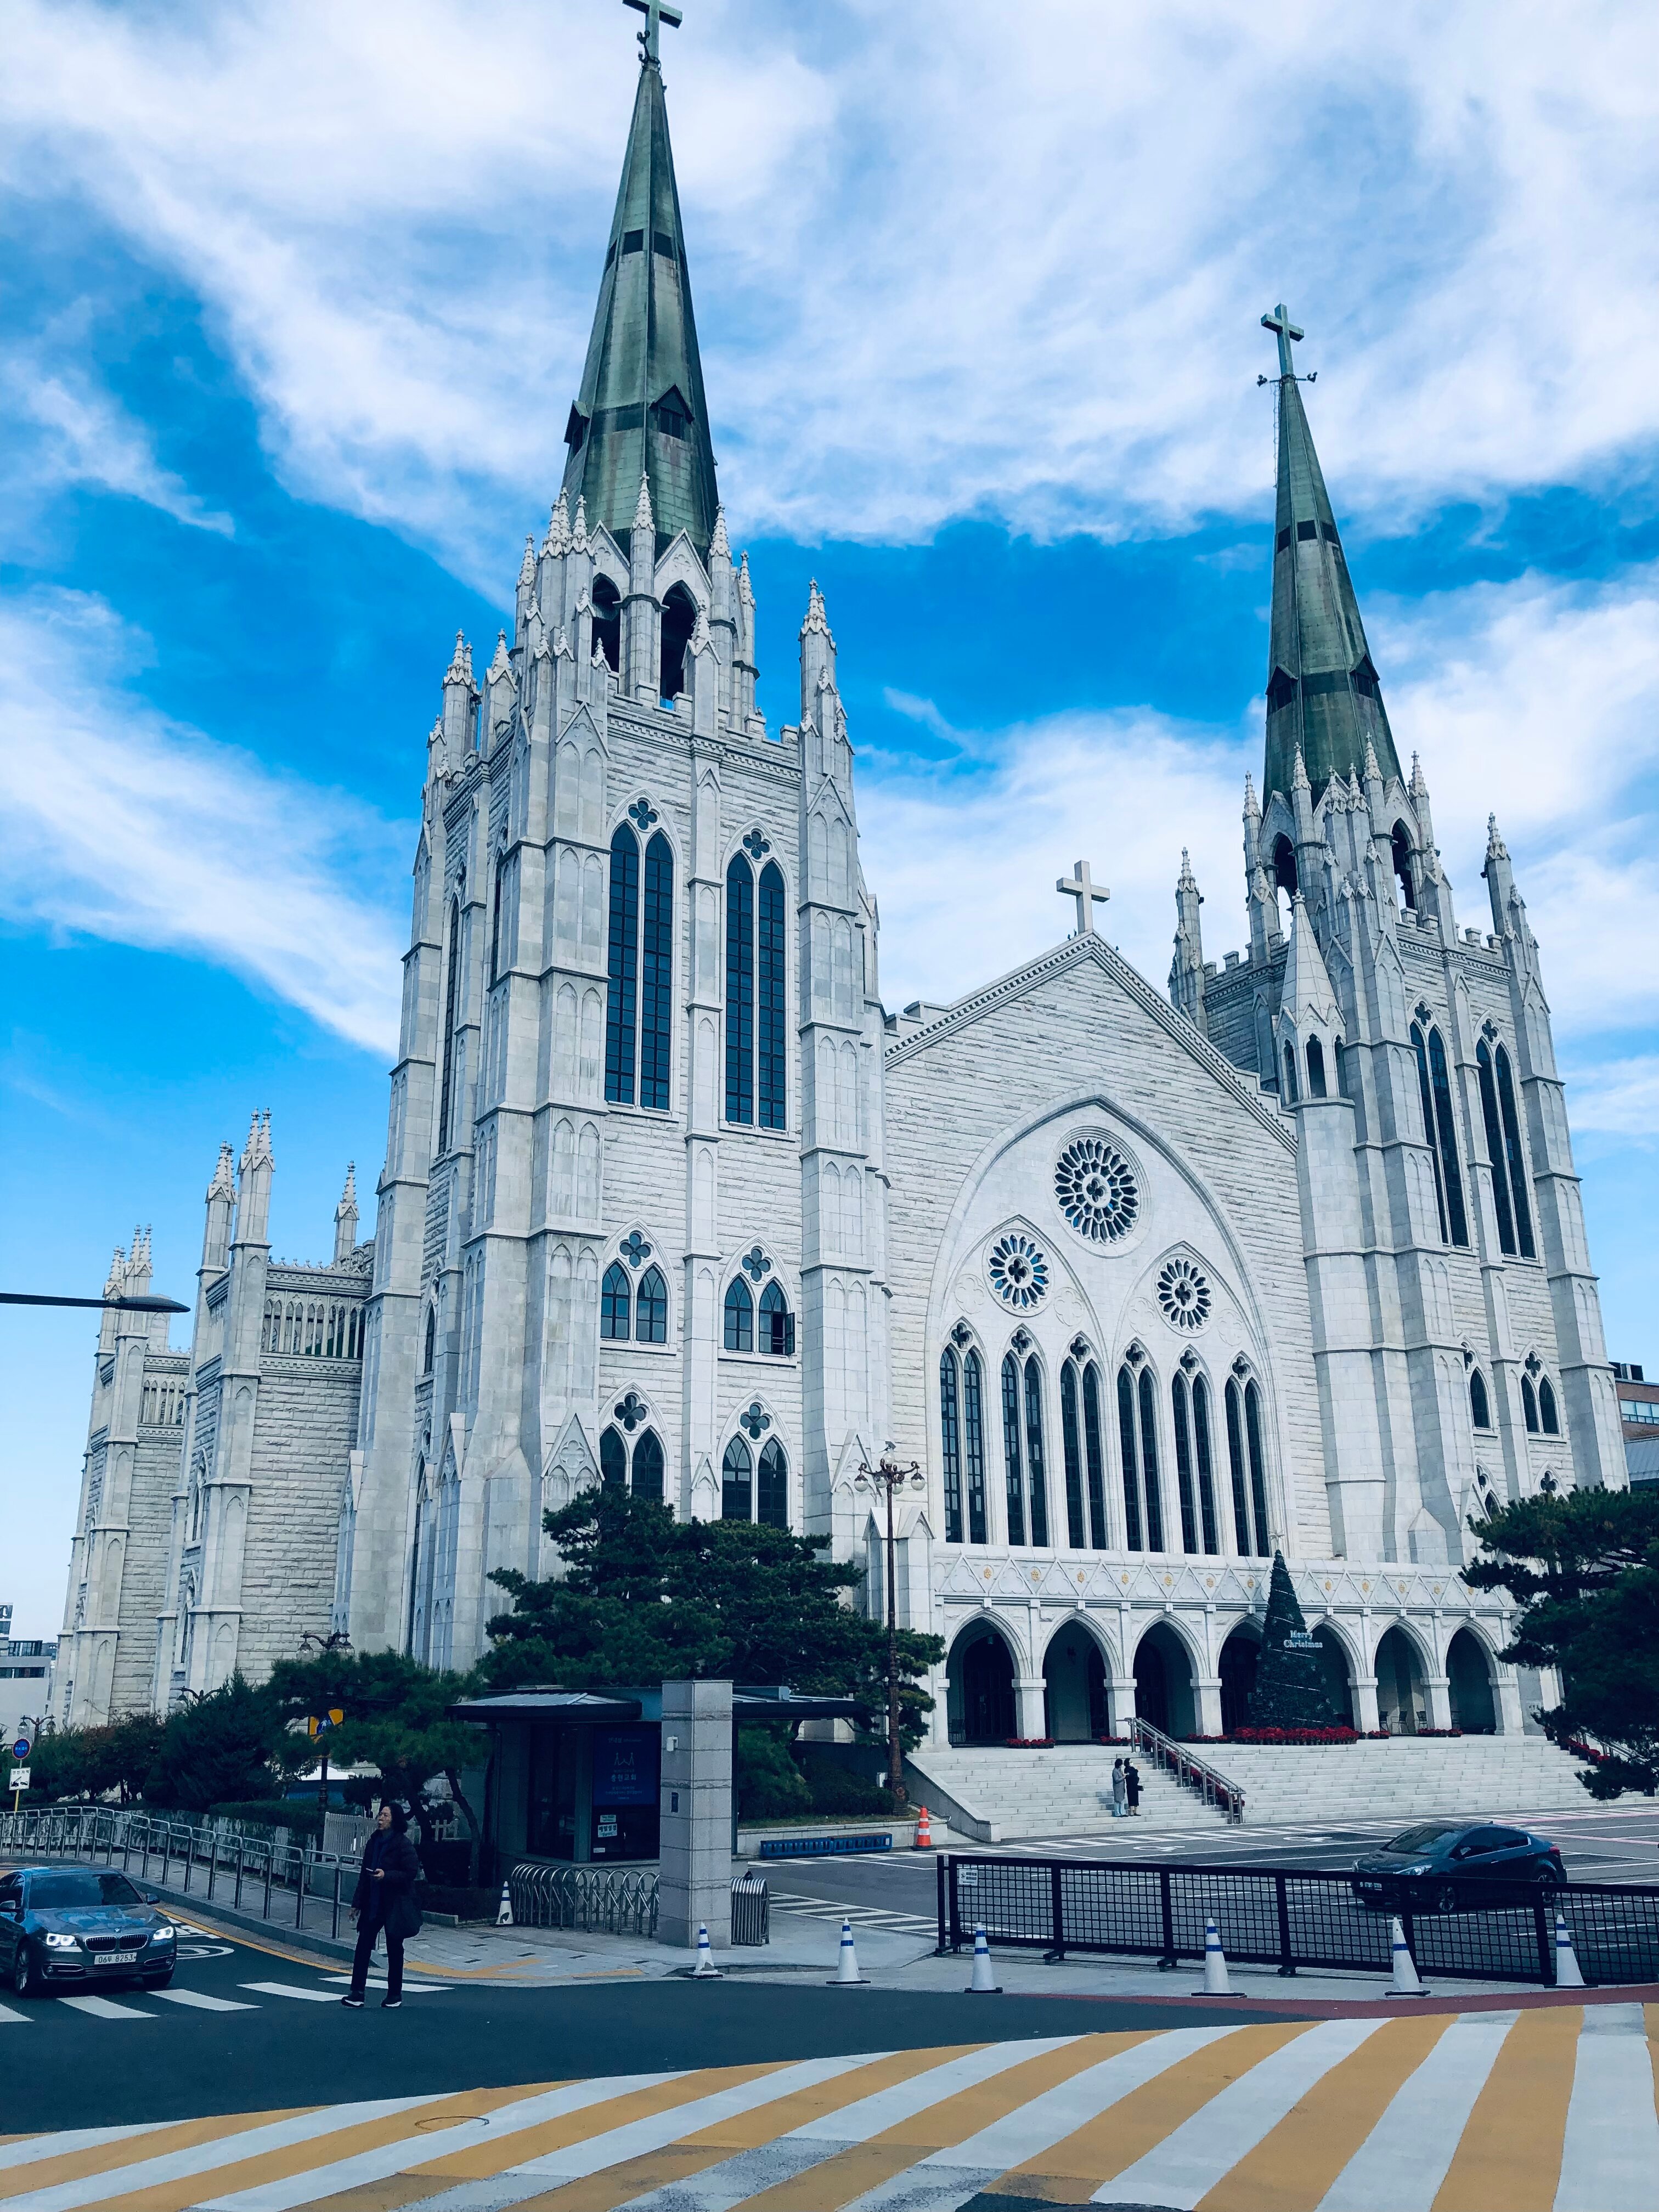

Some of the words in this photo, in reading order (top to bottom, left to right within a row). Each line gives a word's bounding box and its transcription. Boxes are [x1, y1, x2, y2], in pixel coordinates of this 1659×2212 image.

[1290, 1630, 1313, 1639] Merry
[1283, 1639, 1323, 1648] Christmas
[115, 1954, 133, 1962] 8253
